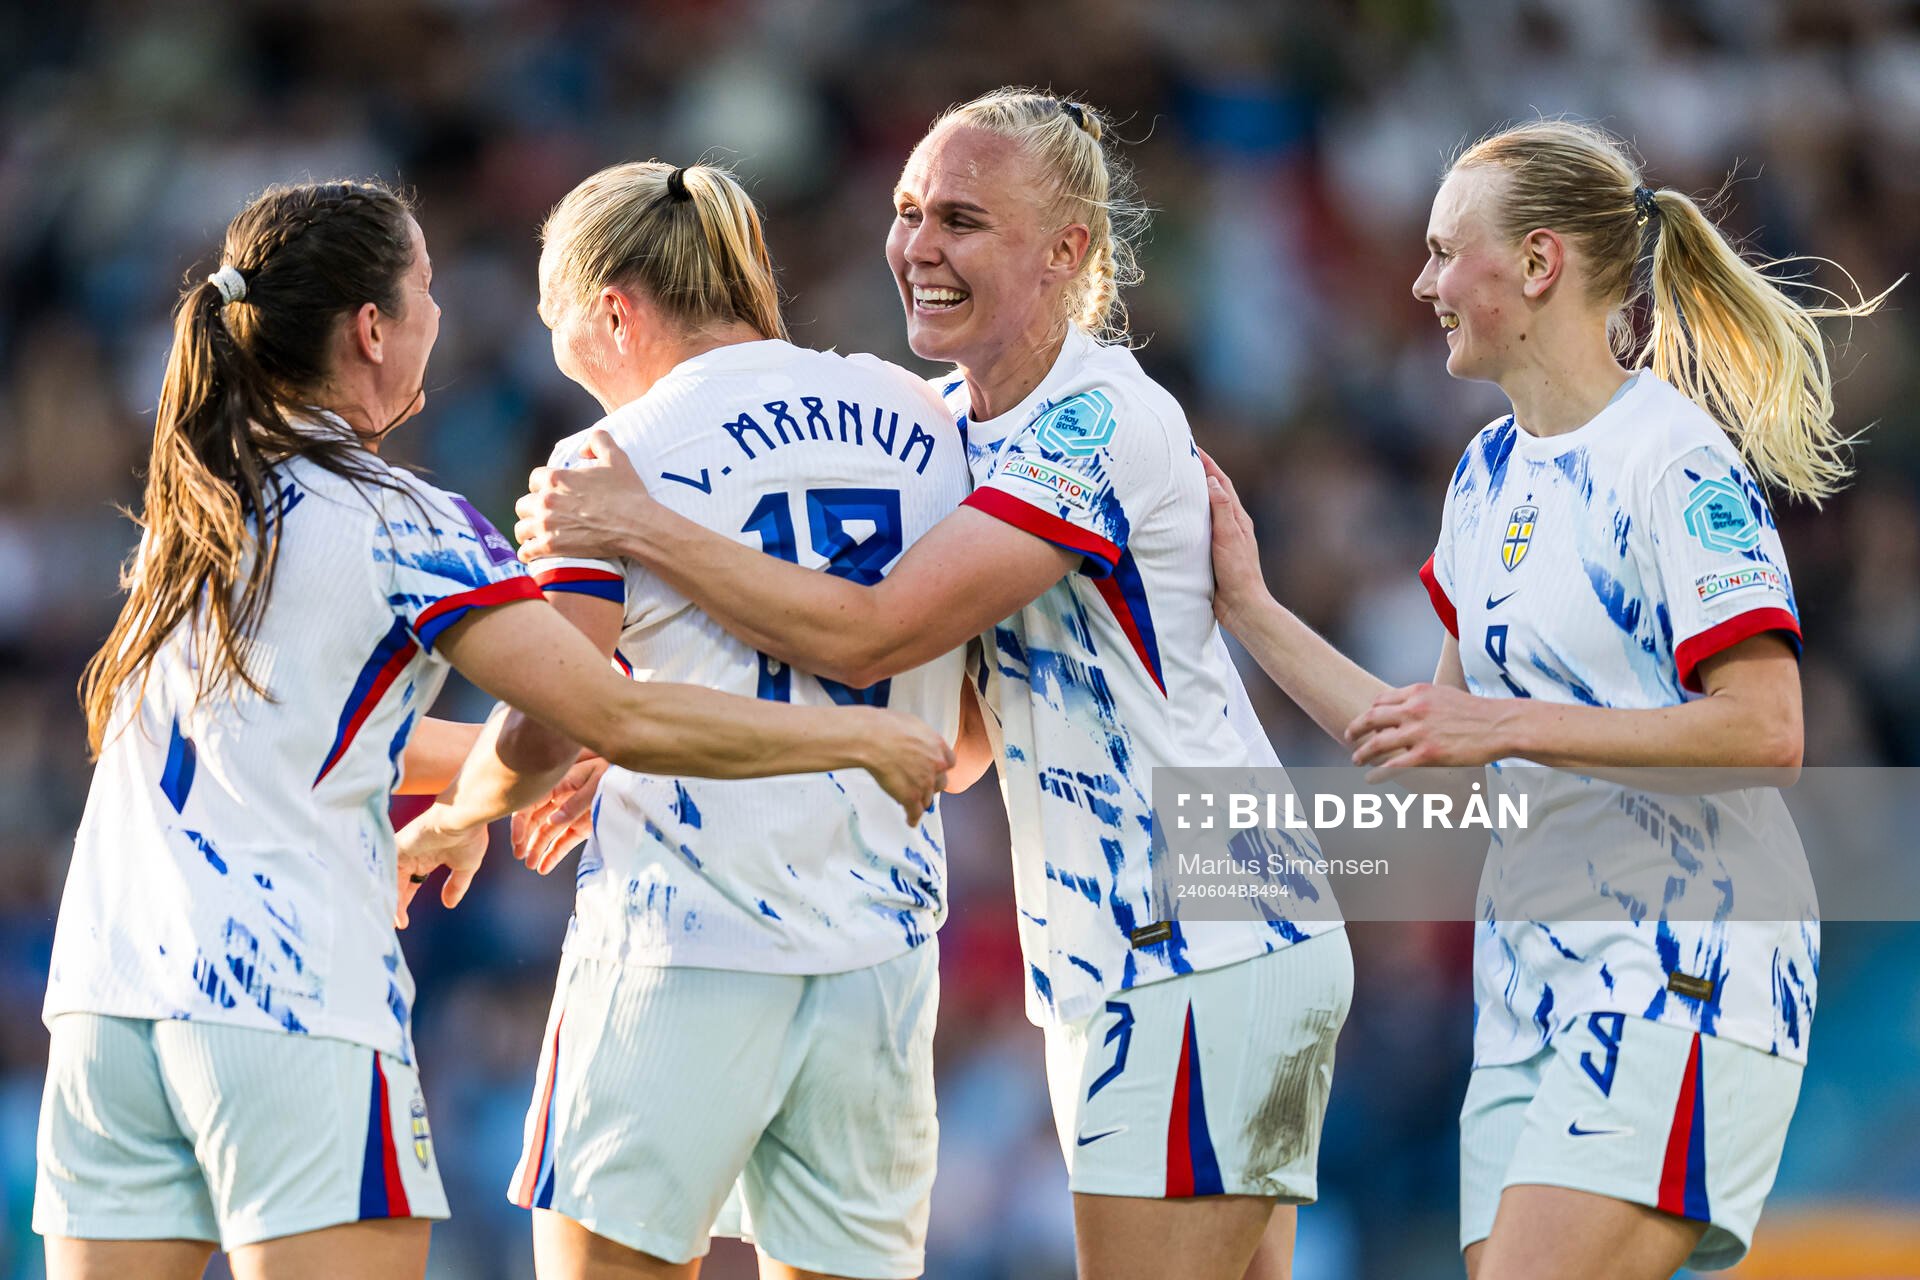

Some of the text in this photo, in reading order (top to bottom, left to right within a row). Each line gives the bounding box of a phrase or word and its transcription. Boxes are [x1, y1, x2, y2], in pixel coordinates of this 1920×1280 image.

[1059, 414, 1079, 425] play
[1003, 462, 1092, 502] FOUNDATION
[1697, 571, 1782, 599] FOUNDATIO
